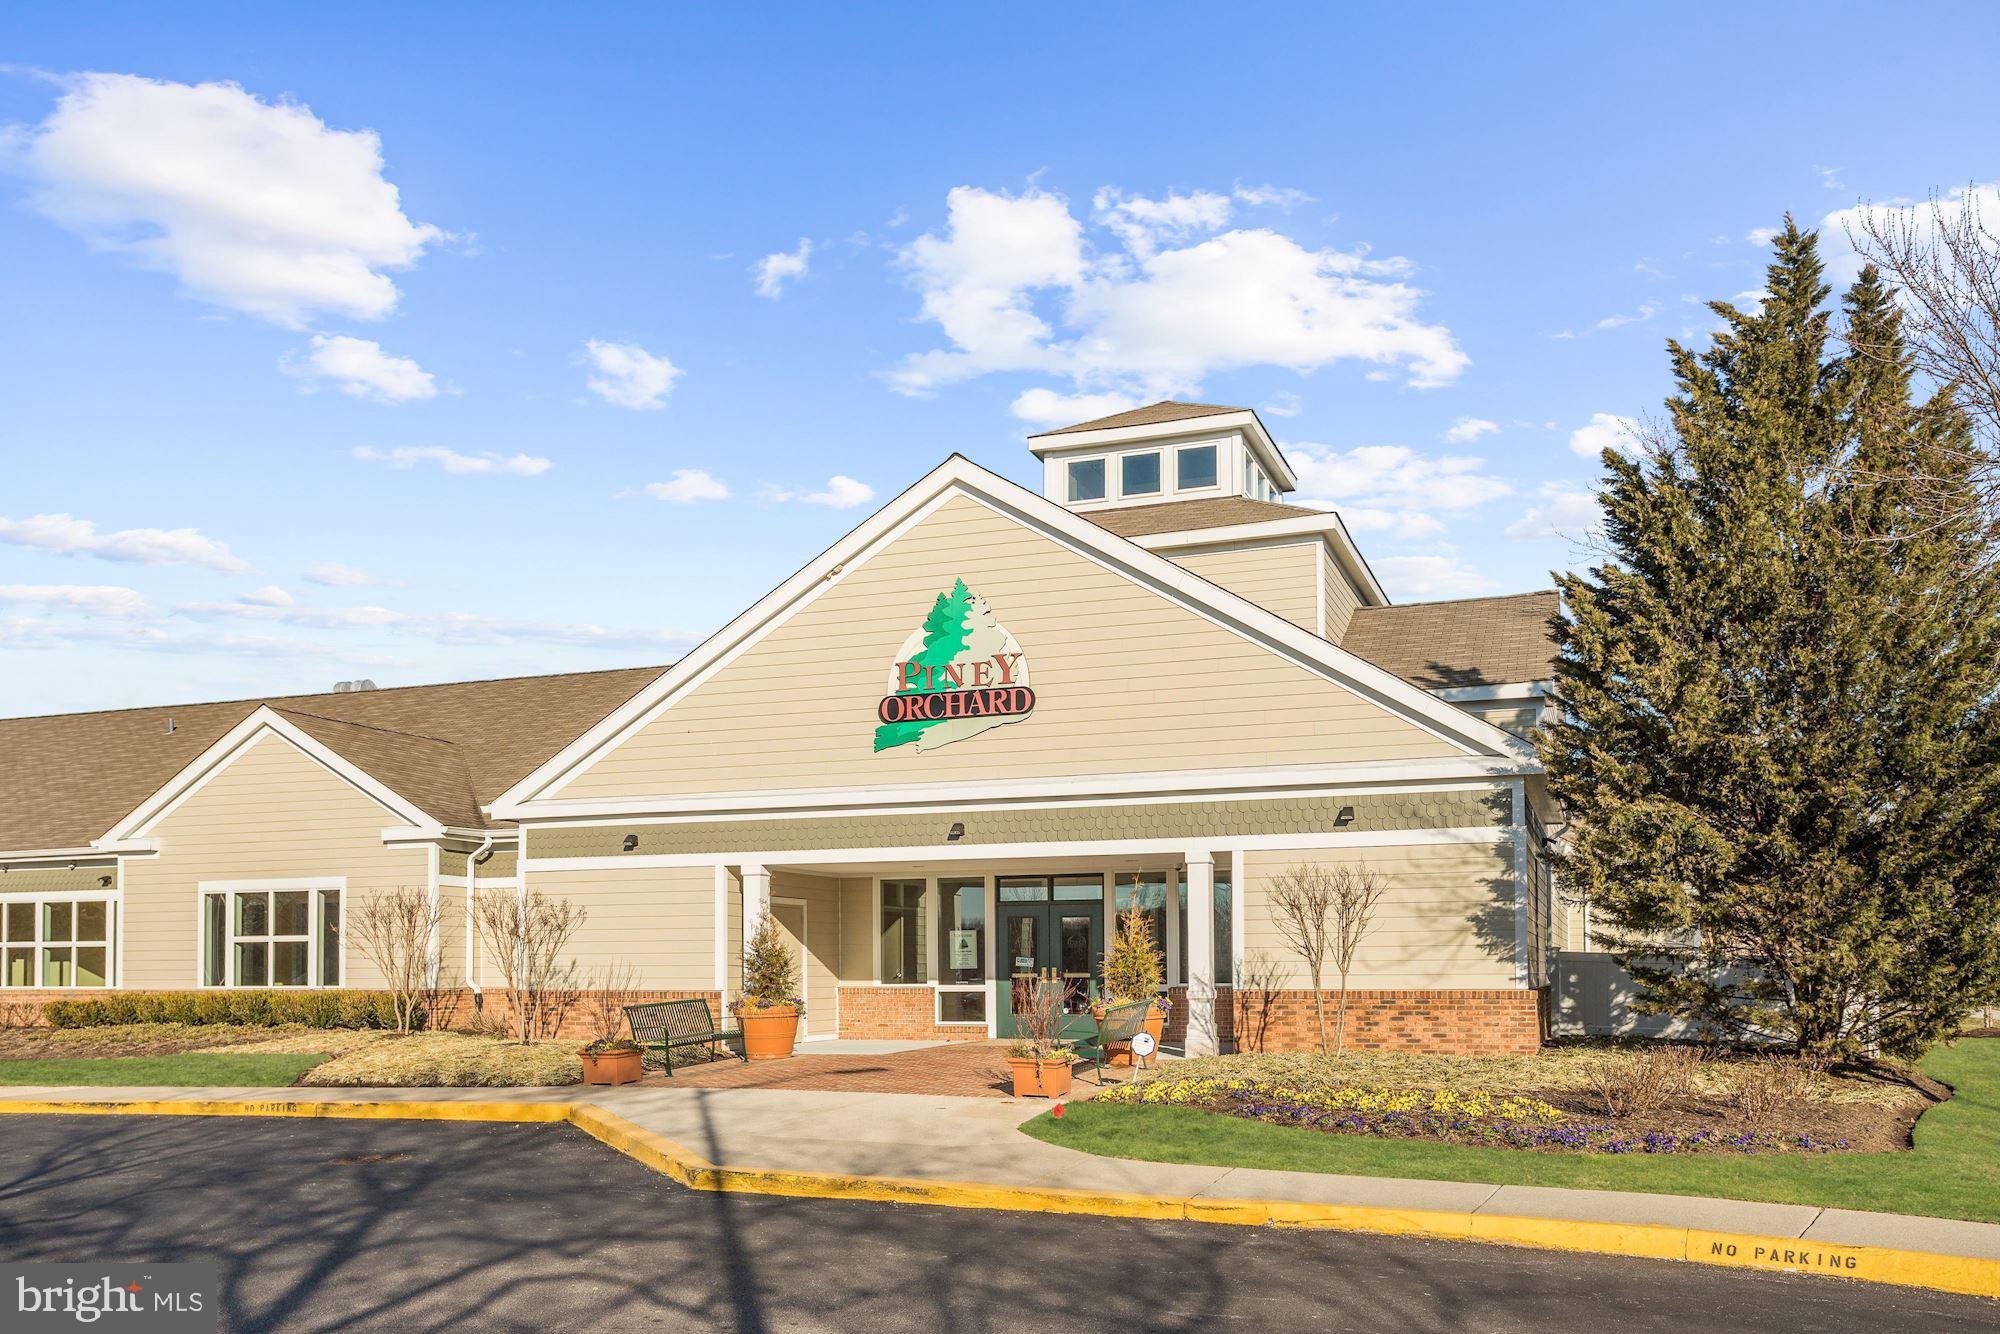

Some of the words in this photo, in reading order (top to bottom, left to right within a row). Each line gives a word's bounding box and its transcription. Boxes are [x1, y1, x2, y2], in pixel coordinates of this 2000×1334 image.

[895, 653, 1023, 693] PINEY
[881, 688, 1032, 722] ORCHARD
[244, 1104, 255, 1112] NO
[260, 1103, 297, 1112] PARKING
[1711, 1242, 1737, 1257] NO
[1754, 1247, 1857, 1269] PARKING
